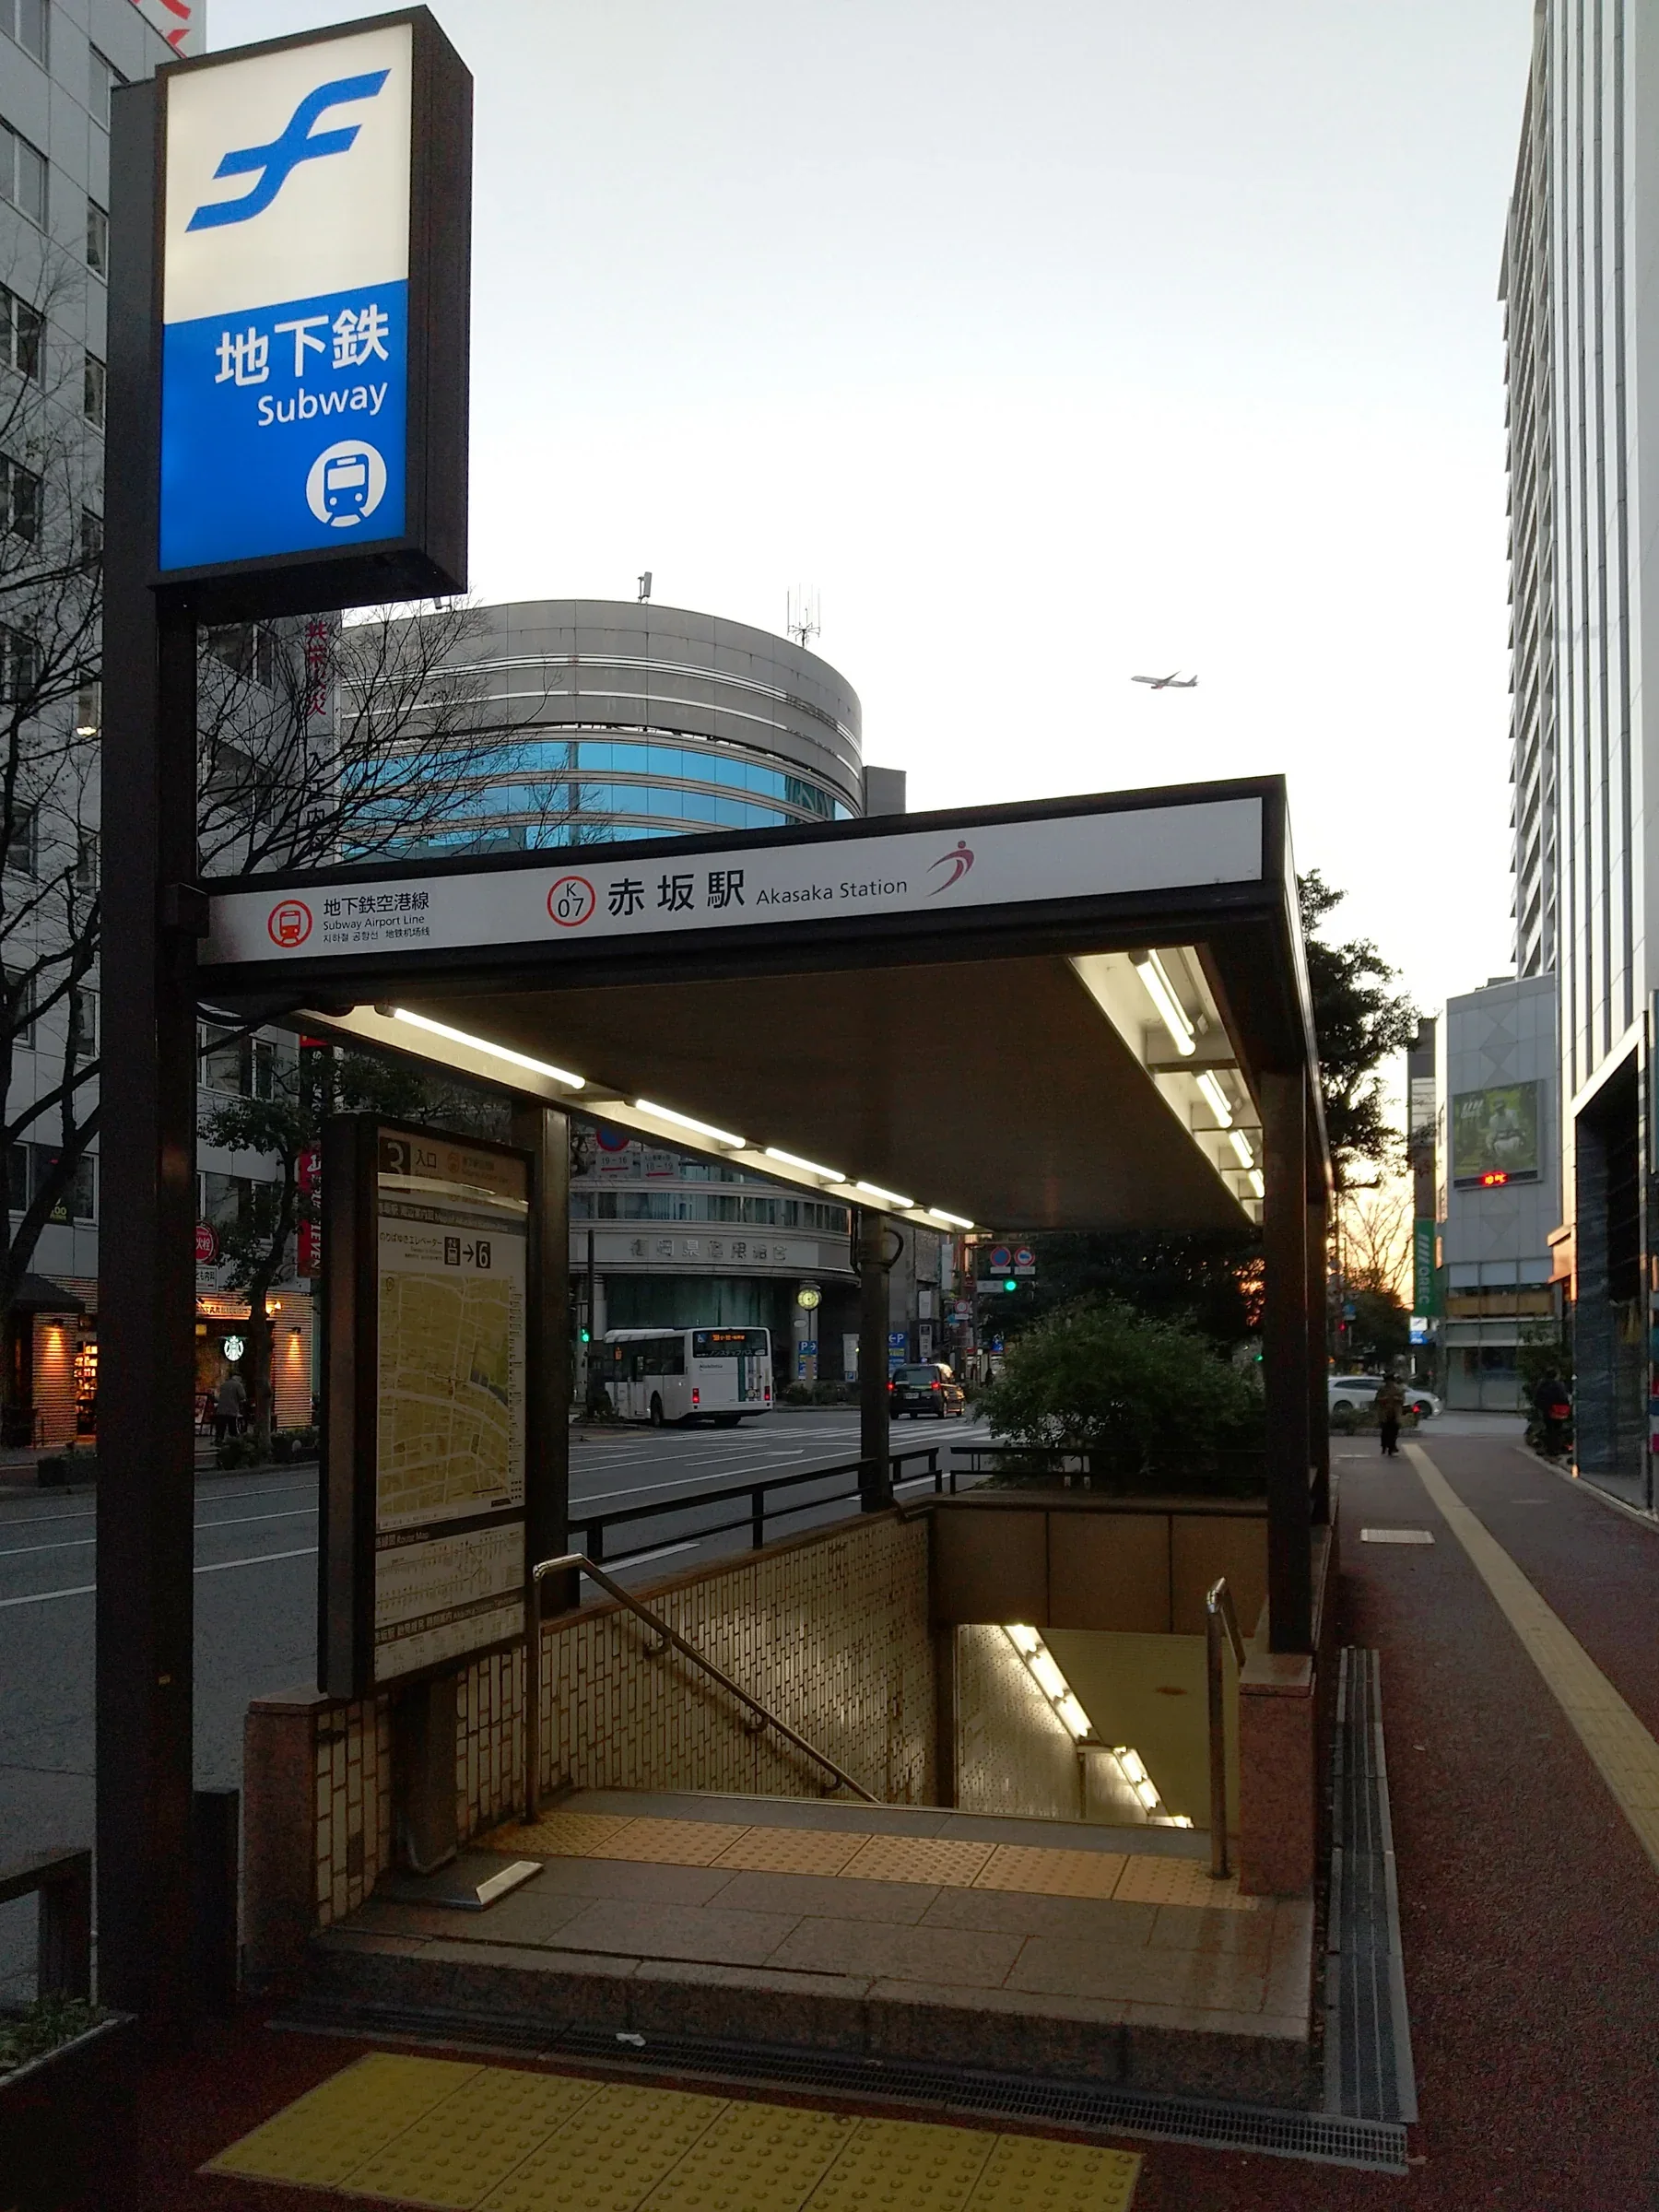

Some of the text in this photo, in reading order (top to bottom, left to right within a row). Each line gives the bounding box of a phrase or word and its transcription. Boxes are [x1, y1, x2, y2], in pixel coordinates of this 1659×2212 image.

[215, 304, 389, 386] 地下鉄
[258, 382, 388, 427] Subway
[566, 882, 577, 898] K
[607, 869, 746, 917] 赤坂駅
[756, 878, 908, 905] Akasaka Station
[324, 891, 429, 916] 地下鉄空港線
[558, 898, 584, 918] 07
[324, 914, 425, 931] Subway Airport Line
[416, 1148, 437, 1169] 入口
[478, 1242, 490, 1269] 6
[1418, 1266, 1431, 1305] OREC
[801, 1341, 809, 1351] P
[897, 1333, 906, 1344] P
